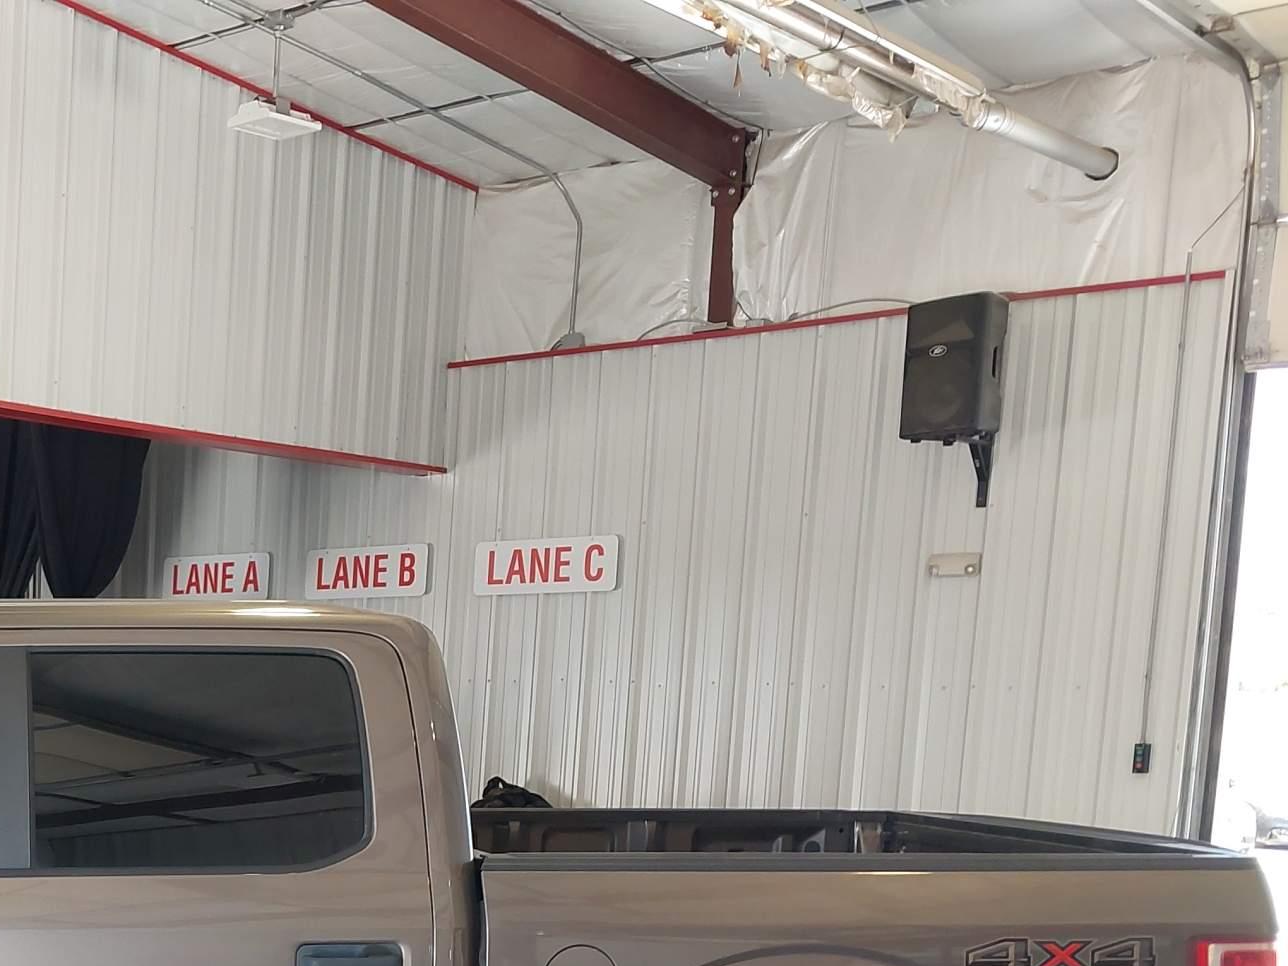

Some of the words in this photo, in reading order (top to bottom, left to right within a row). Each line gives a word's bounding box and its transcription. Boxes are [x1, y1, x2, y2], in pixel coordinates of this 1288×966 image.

[171, 562, 234, 595] LANE
[242, 561, 259, 592] A
[316, 554, 388, 590] LANE
[398, 552, 417, 588] B
[486, 546, 572, 586] LANE
[583, 543, 605, 582] C
